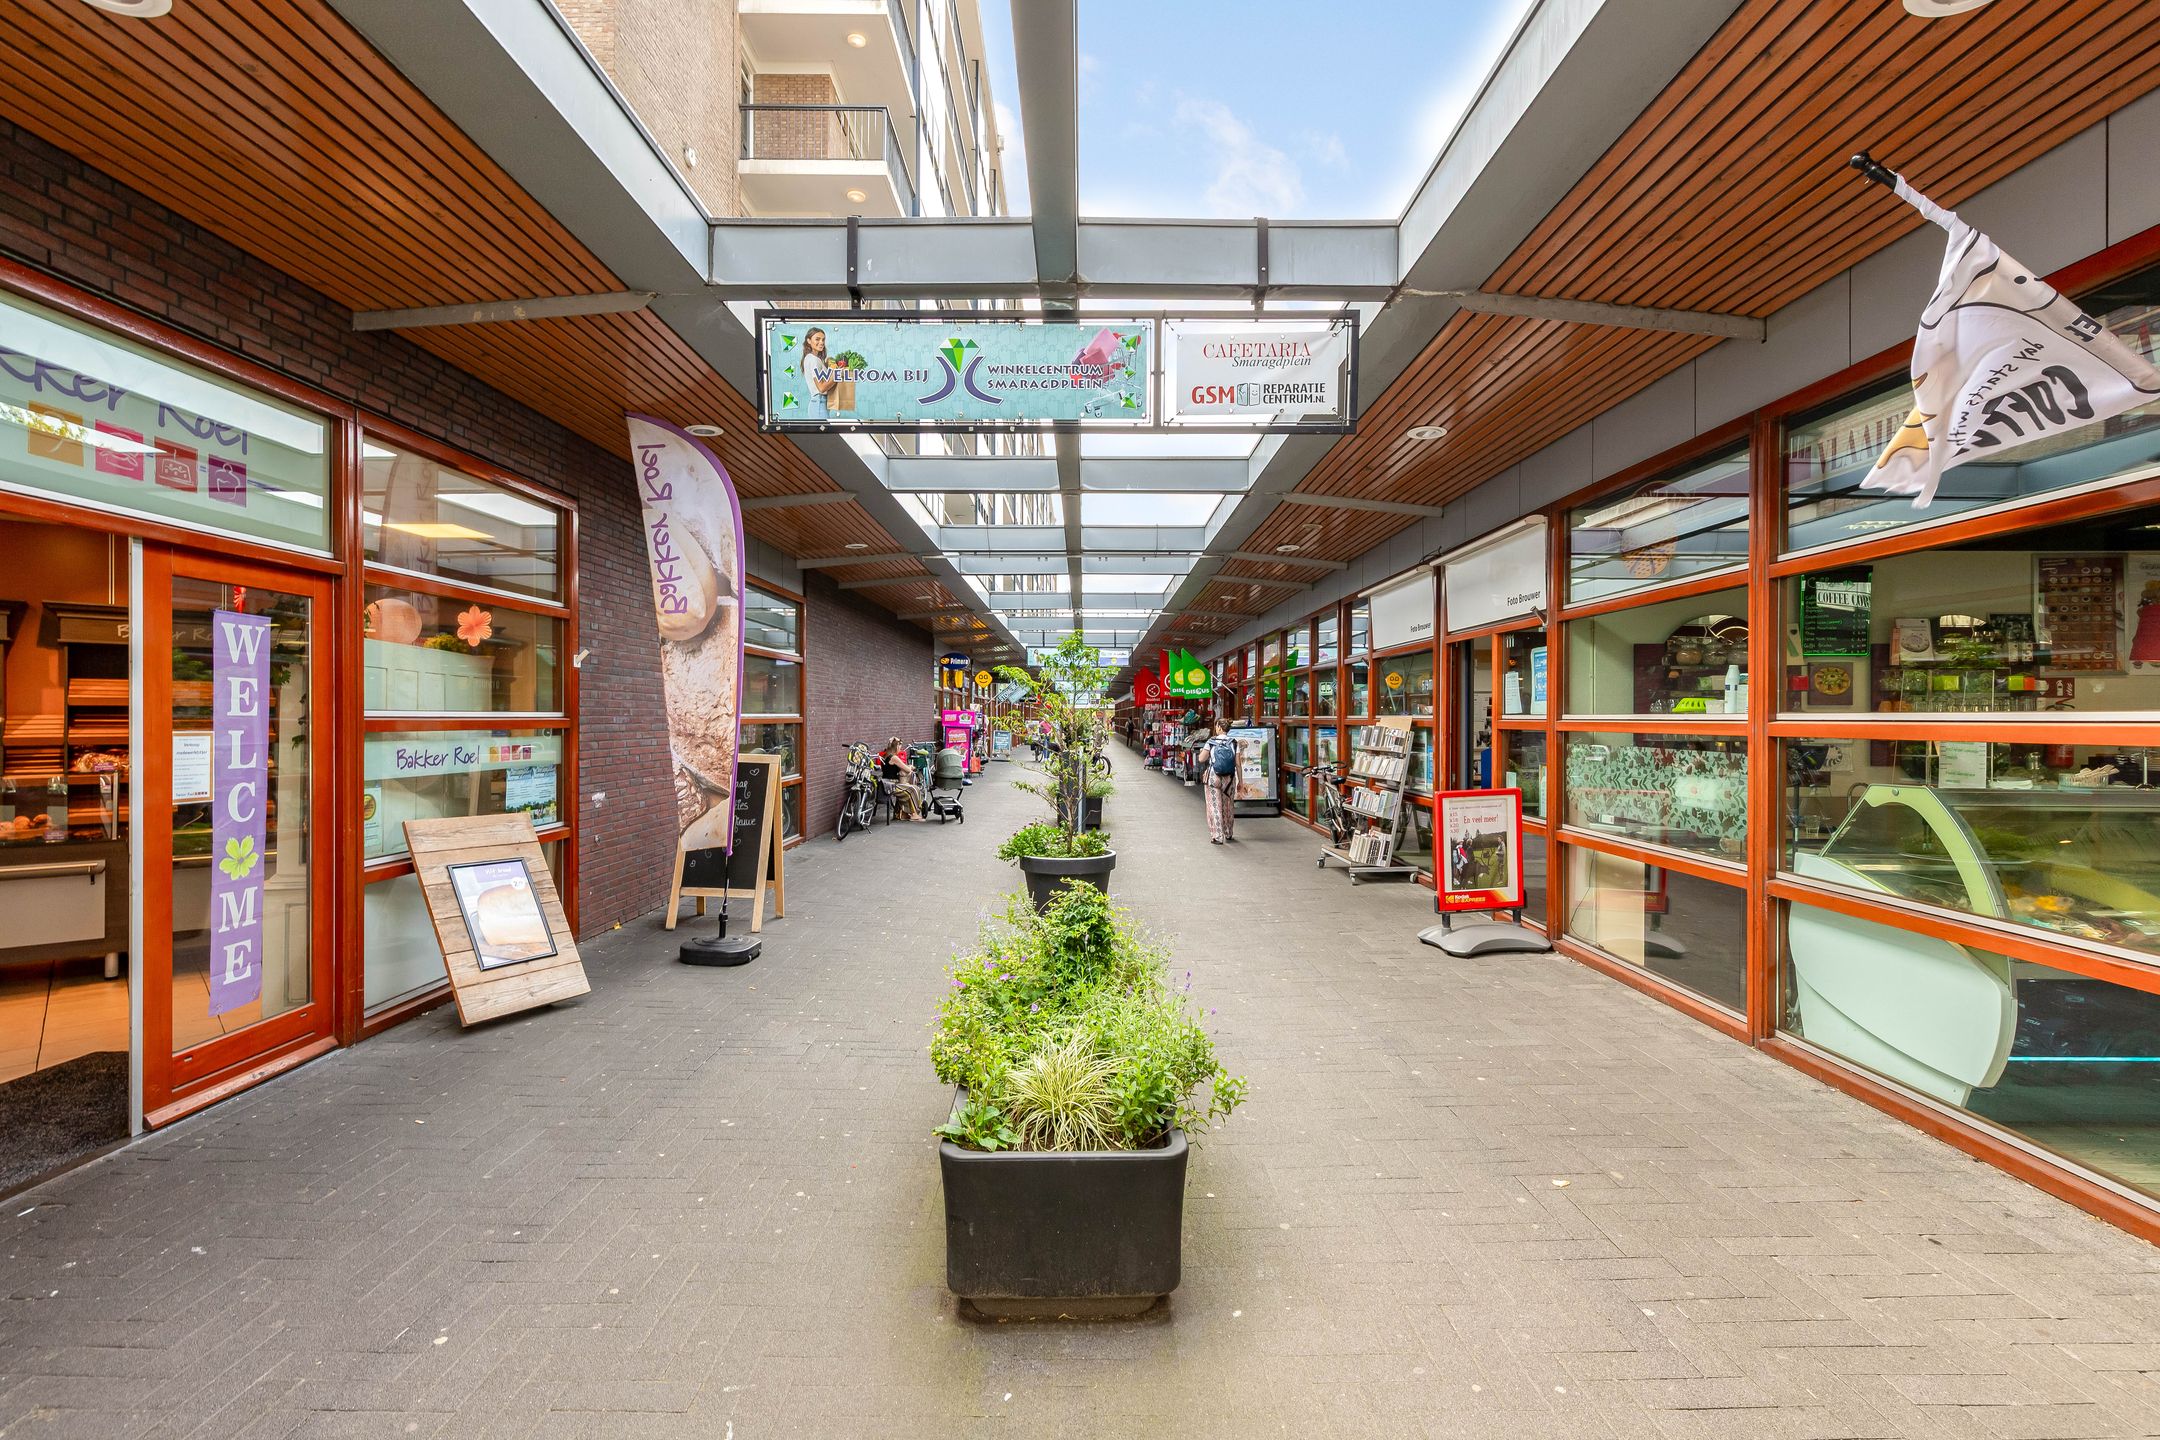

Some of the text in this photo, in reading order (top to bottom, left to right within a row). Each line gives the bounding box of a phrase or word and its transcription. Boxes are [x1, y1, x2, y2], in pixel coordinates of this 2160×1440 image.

[1203, 342, 1313, 358] CAFETARIA
[987, 365, 1103, 375] WINKELCENTRUM
[1232, 354, 1312, 370] Smaragdplein
[813, 367, 930, 383] WELKOM BIJ
[987, 379, 1103, 389] SMARAGDPLEIN
[1263, 382, 1326, 394] REPARATIE
[1191, 386, 1236, 405] GSM
[1263, 394, 1326, 404] CENTRUM.NL
[1817, 410, 1910, 475] VLAAIE
[1507, 591, 1541, 607] Foto Brouwer
[1817, 591, 1849, 605] COFFEE
[396, 745, 480, 770] Bakker Roel
[219, 622, 265, 986] WELCME
